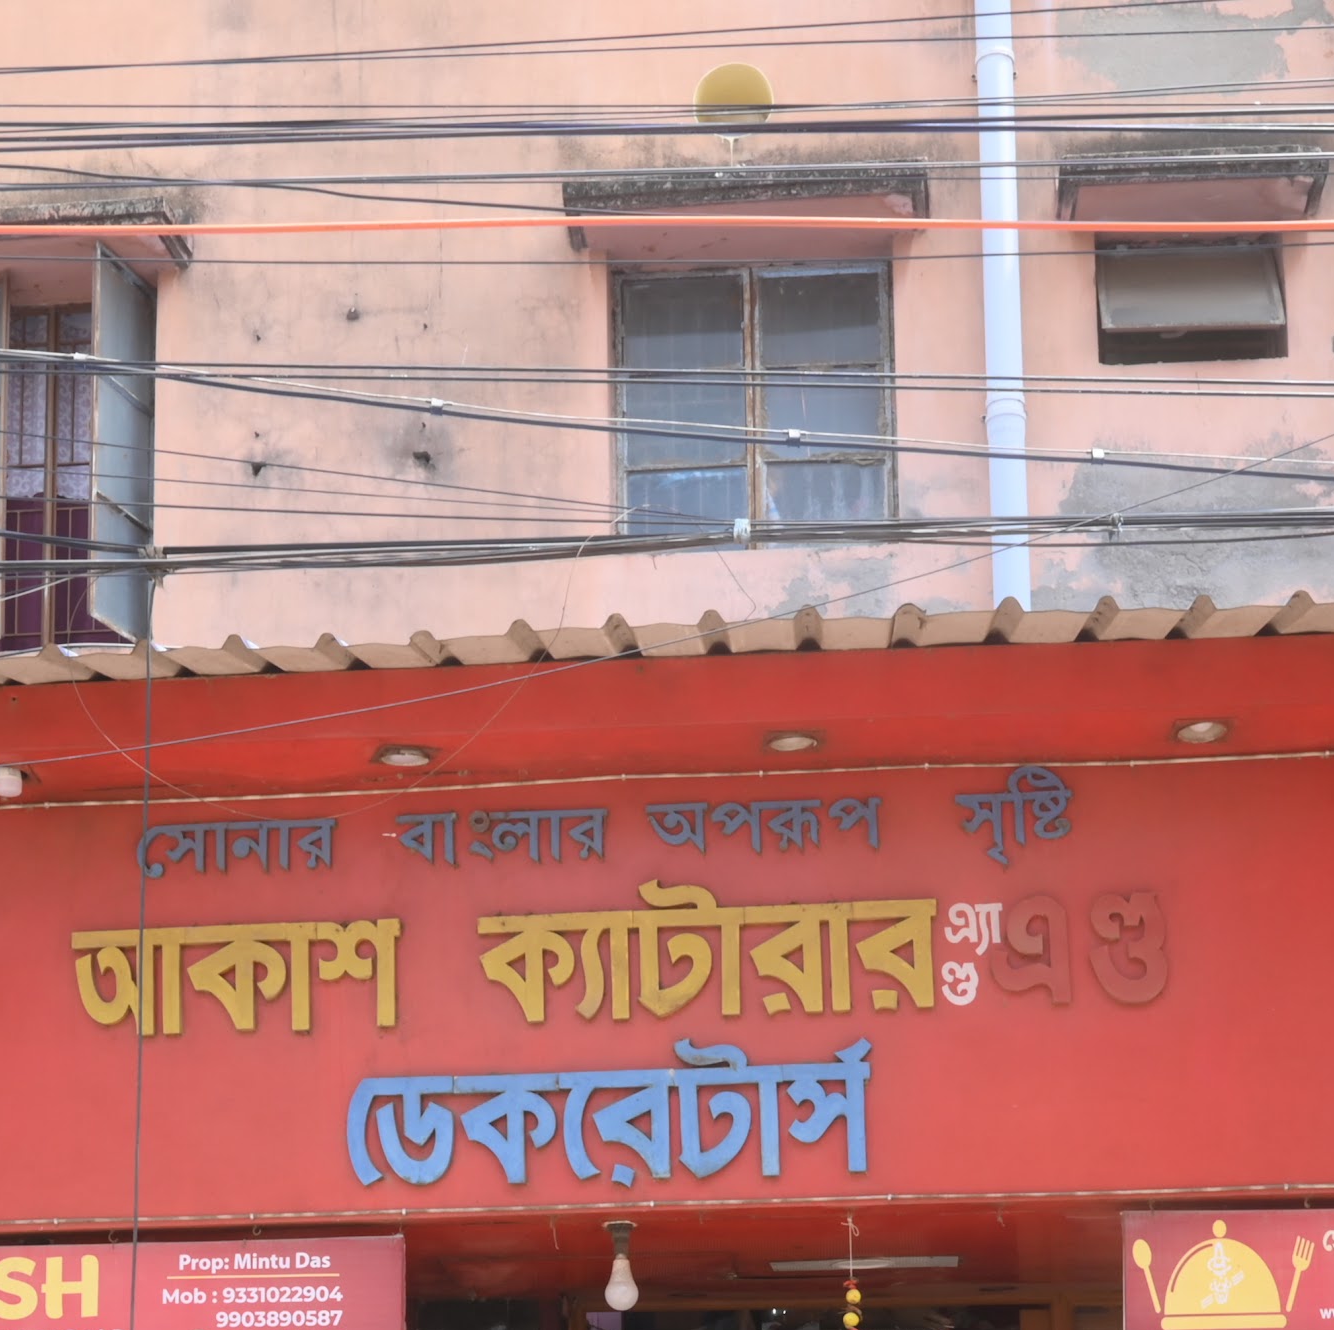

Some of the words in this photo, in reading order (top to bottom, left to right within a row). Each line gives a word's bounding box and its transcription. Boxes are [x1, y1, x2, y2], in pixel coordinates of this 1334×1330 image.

[136, 817, 337, 878] সোনার
[395, 808, 607, 868] বাংলার
[646, 797, 881, 853] অপরূপ
[955, 765, 1072, 864] সৃষ্টি
[71, 917, 402, 1036] আকাশ
[477, 879, 937, 1024] ক্যাটারার
[346, 1038, 873, 1188] ডেকরেটার্স
[178, 1252, 229, 1276] Prop:
[234, 1251, 290, 1270] Mintu
[294, 1251, 331, 1270] Das
[222, 1285, 343, 1304] 9331022904
[216, 1309, 343, 1328] 9903890587
